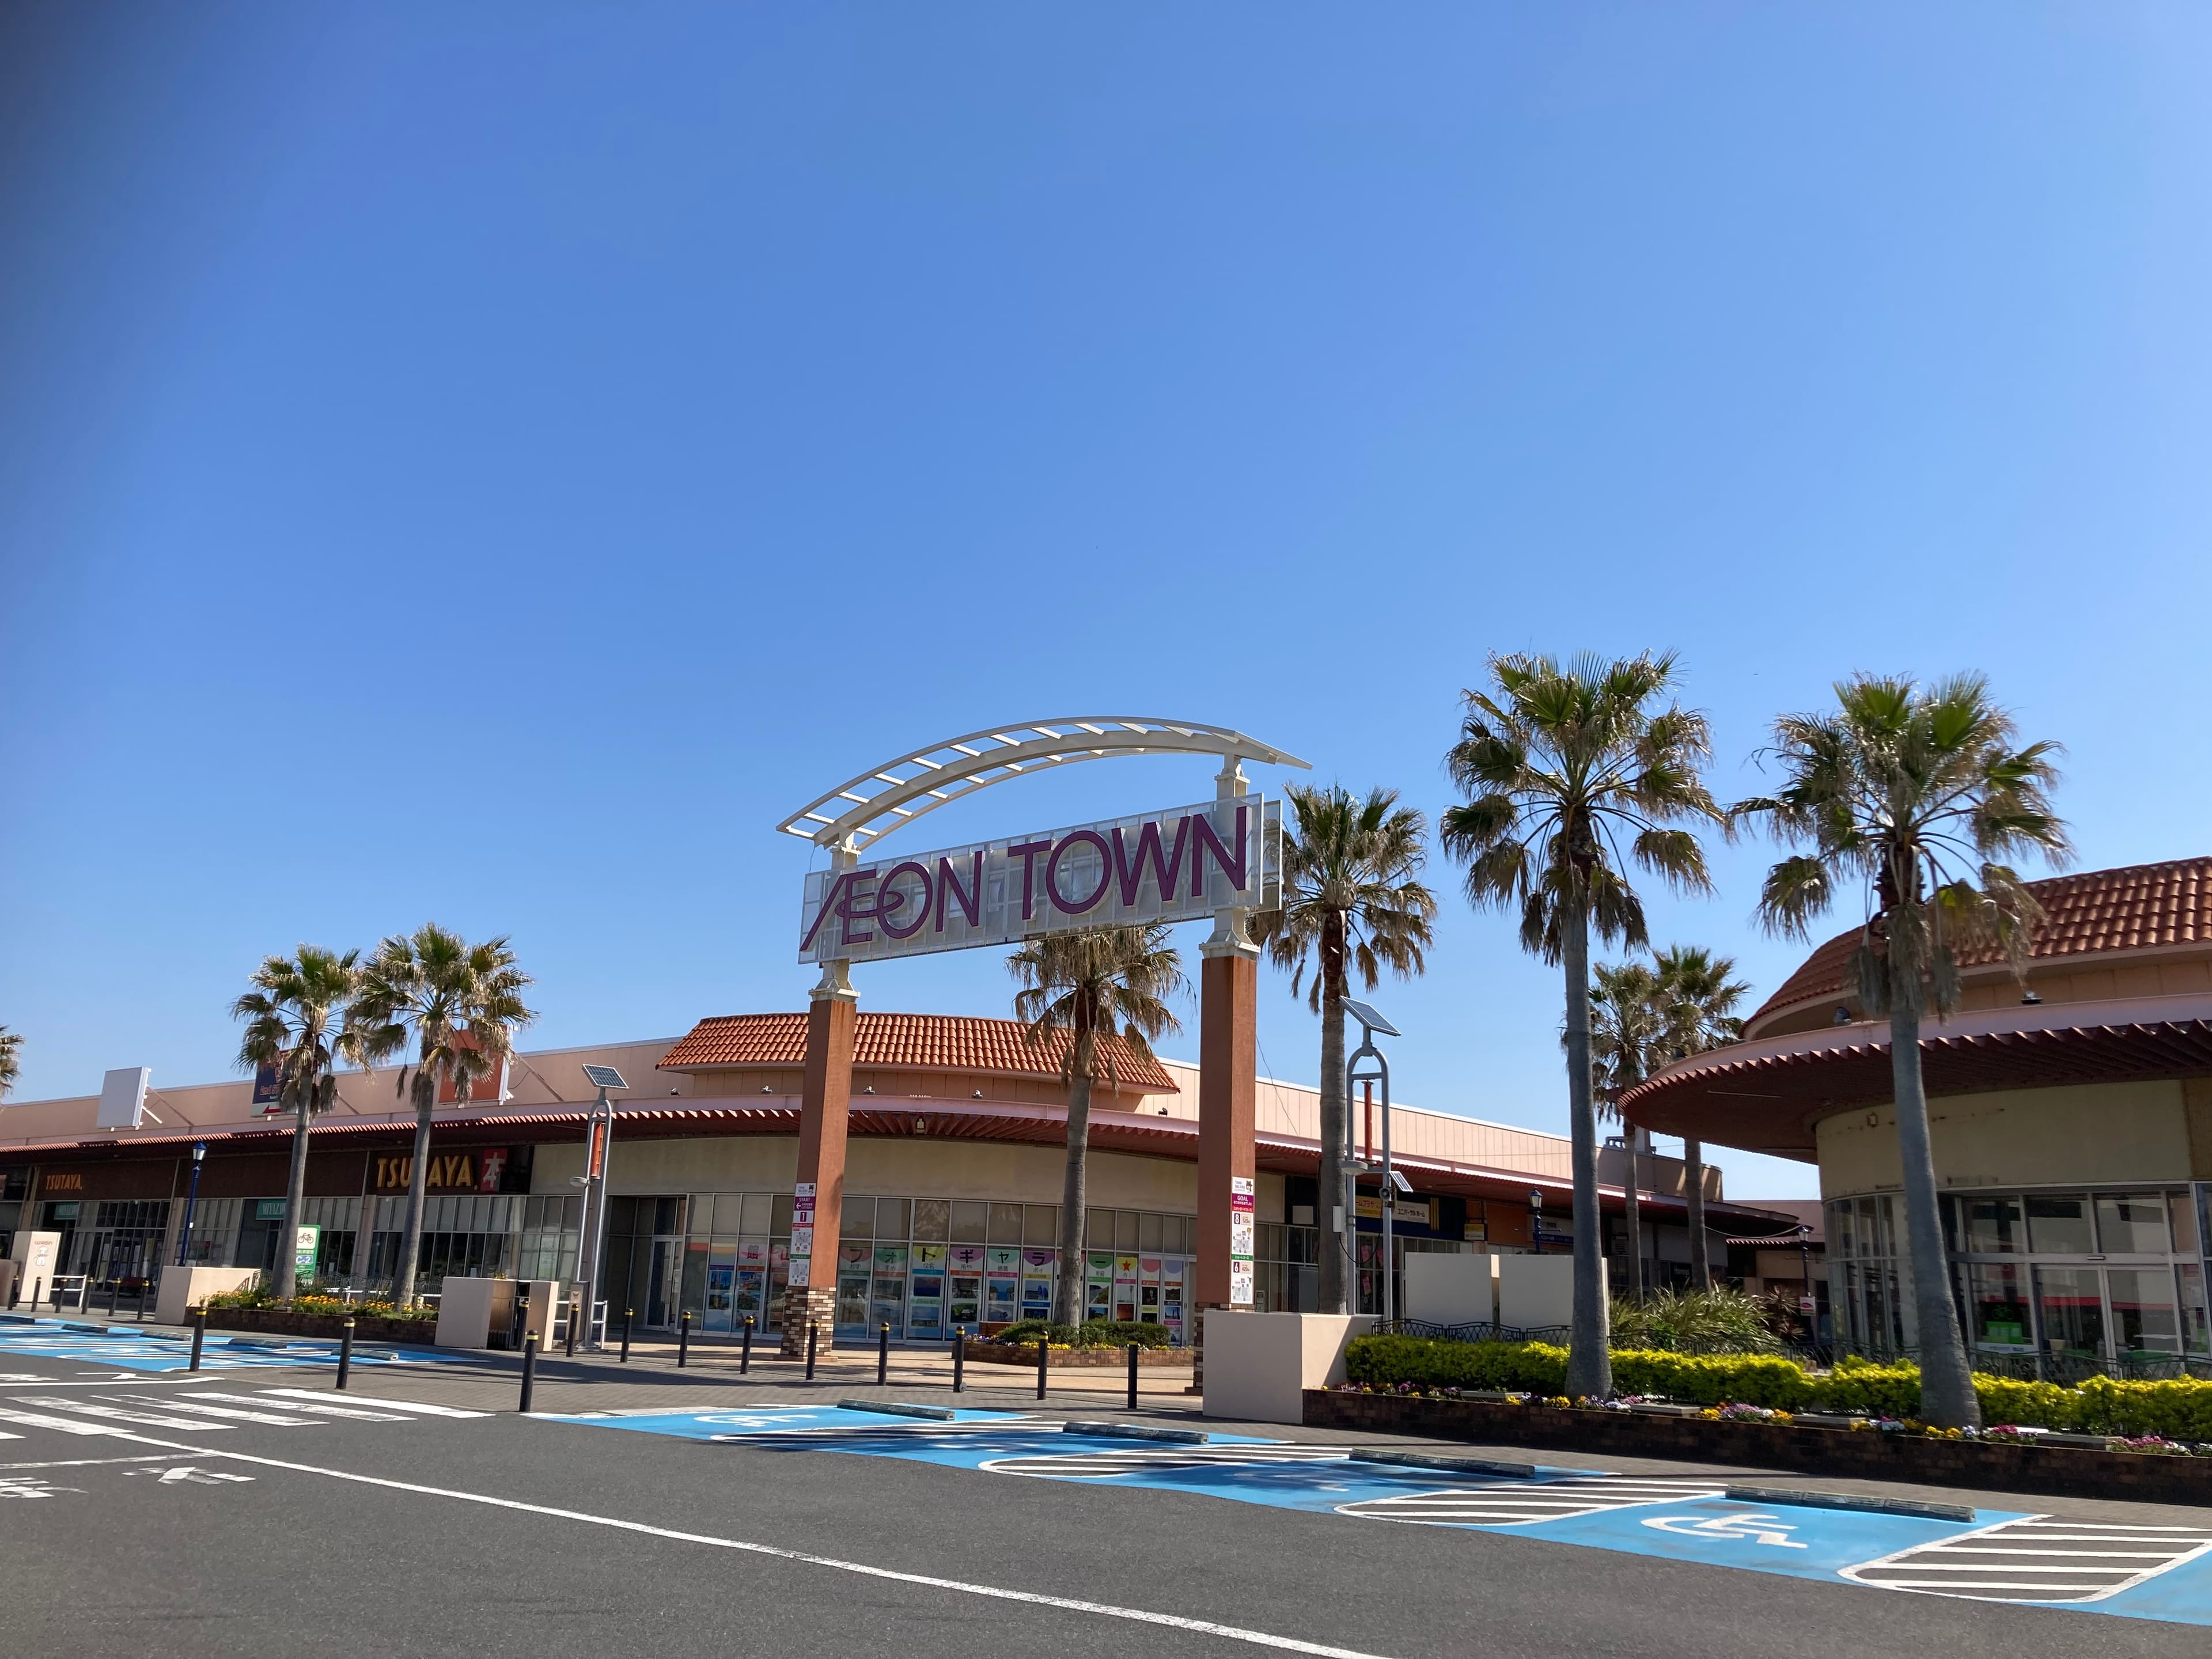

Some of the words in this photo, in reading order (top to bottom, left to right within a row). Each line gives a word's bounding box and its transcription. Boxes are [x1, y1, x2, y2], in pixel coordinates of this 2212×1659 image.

[1007, 806, 1247, 920] TOWN
[377, 1155, 478, 1191] TSUAYA.
[1235, 1214, 1240, 1224] 8
[1234, 1262, 1238, 1272] 6
